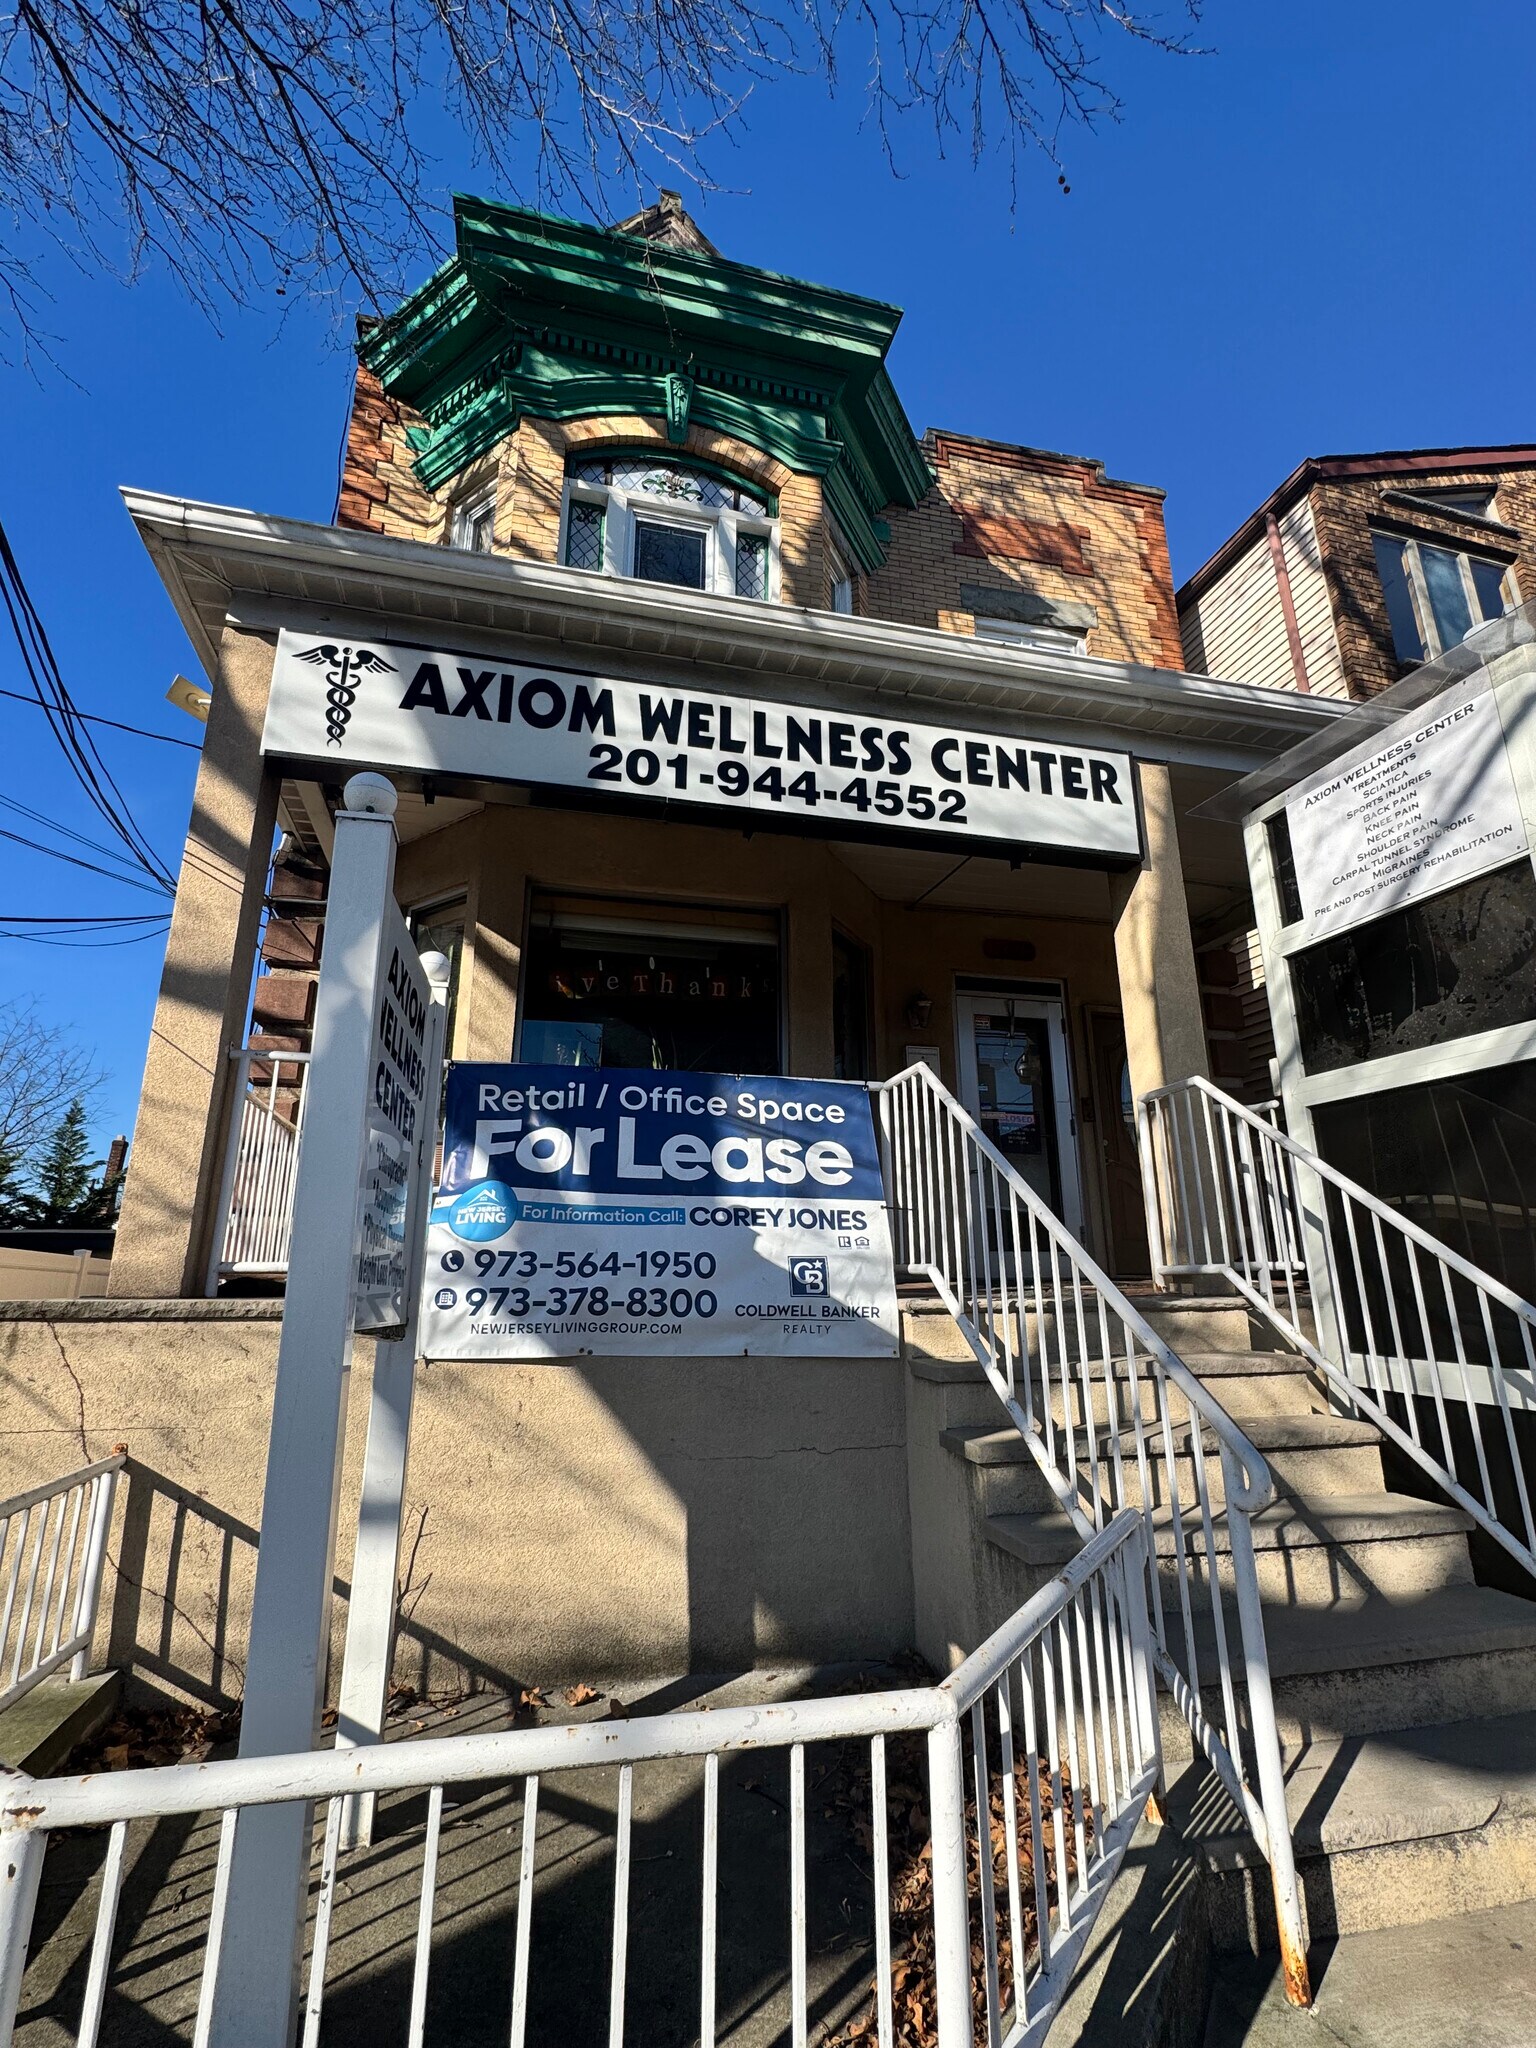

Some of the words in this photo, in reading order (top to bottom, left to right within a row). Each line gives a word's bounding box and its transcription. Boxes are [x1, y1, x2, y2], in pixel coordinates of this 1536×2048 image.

[398, 662, 616, 737] AXIOM
[638, 693, 912, 775] WELLNESS
[930, 737, 1123, 804] CENTER
[1304, 781, 1341, 809] AXIOM
[1343, 740, 1412, 785] WELLNESS
[1415, 703, 1474, 743] CENTER
[1352, 752, 1417, 793] TREATMENTS
[587, 743, 968, 824] 201-944-4552
[1346, 796, 1384, 820] SPORTS
[1385, 769, 1432, 799] INJURIES
[1363, 770, 1408, 799] SCIATICA
[1363, 804, 1390, 823] BACK
[1392, 789, 1417, 807] PAIN
[1365, 816, 1392, 834] KNEE
[1394, 801, 1419, 819] PAIN
[1357, 833, 1410, 863] SHOULDER
[1412, 818, 1438, 836] PAIN
[1367, 827, 1395, 845] NECK
[1397, 813, 1422, 831] PAIN
[1332, 865, 1370, 886] CARPAL
[1371, 845, 1412, 868] TUNNEL
[1413, 813, 1476, 848] SYNDROME
[1372, 848, 1431, 880] MIGRAINES
[1314, 905, 1332, 918] PRE
[1333, 896, 1351, 910] AND
[1353, 885, 1376, 899] POST
[1377, 865, 1421, 890] SURGERY
[1423, 823, 1513, 870] REHABILITATION
[387, 945, 426, 1047] AXIOM
[376, 1061, 416, 1146] CENTER
[478, 1081, 585, 1112] Retail
[596, 1083, 609, 1110] /
[619, 1085, 728, 1117] Office
[736, 1092, 846, 1125] Space
[470, 1118, 605, 1180] For
[616, 1115, 854, 1186] Lease
[455, 1212, 507, 1225] LIVING
[477, 1205, 507, 1213] JERSEY
[522, 1205, 547, 1219] For
[551, 1206, 645, 1223] Information
[648, 1209, 684, 1224] Call:
[689, 1206, 787, 1227] COREY
[788, 1208, 868, 1231] JONES
[474, 1249, 716, 1279] 973-564-1950
[465, 1286, 718, 1318] 973-378-8300
[735, 1304, 817, 1318] COLDWELL
[822, 1305, 881, 1318] BANKER
[471, 1322, 682, 1335] NEWJERSEYLIVINGGROUP.COM
[783, 1324, 832, 1334] REALTY
